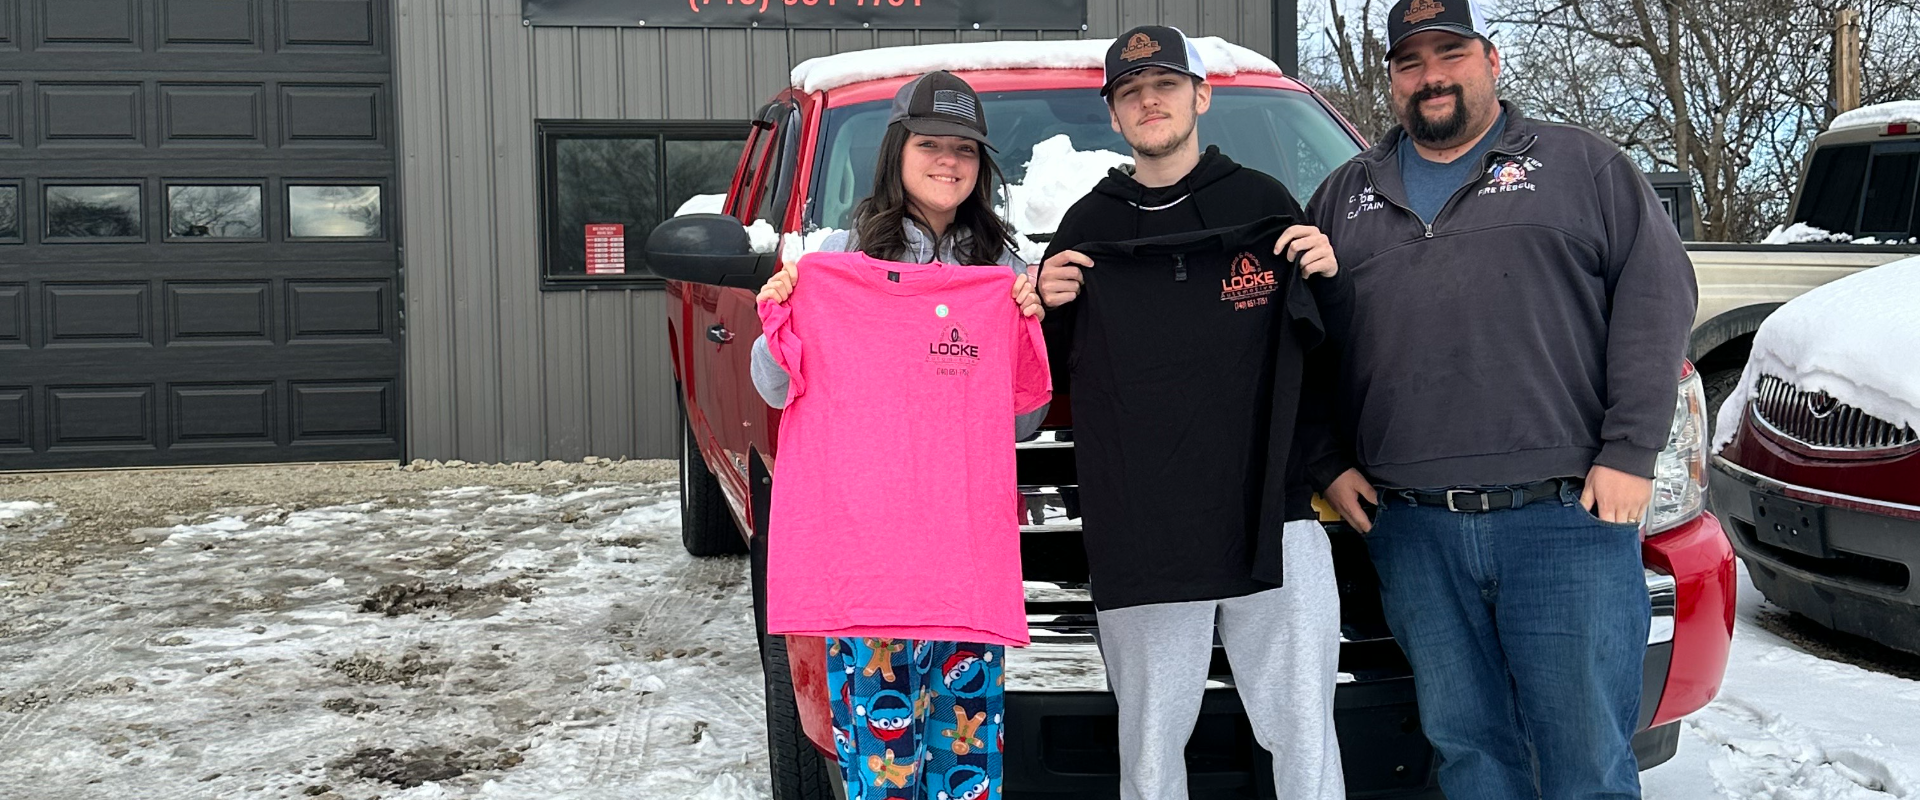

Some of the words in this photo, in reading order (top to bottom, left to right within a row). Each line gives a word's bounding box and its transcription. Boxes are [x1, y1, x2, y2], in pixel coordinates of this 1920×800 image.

[1405, 2, 1440, 16] LOCKE
[1123, 41, 1158, 54] LOCKE
[1222, 270, 1275, 292] LOCKE
[930, 343, 979, 358] LOCKE
